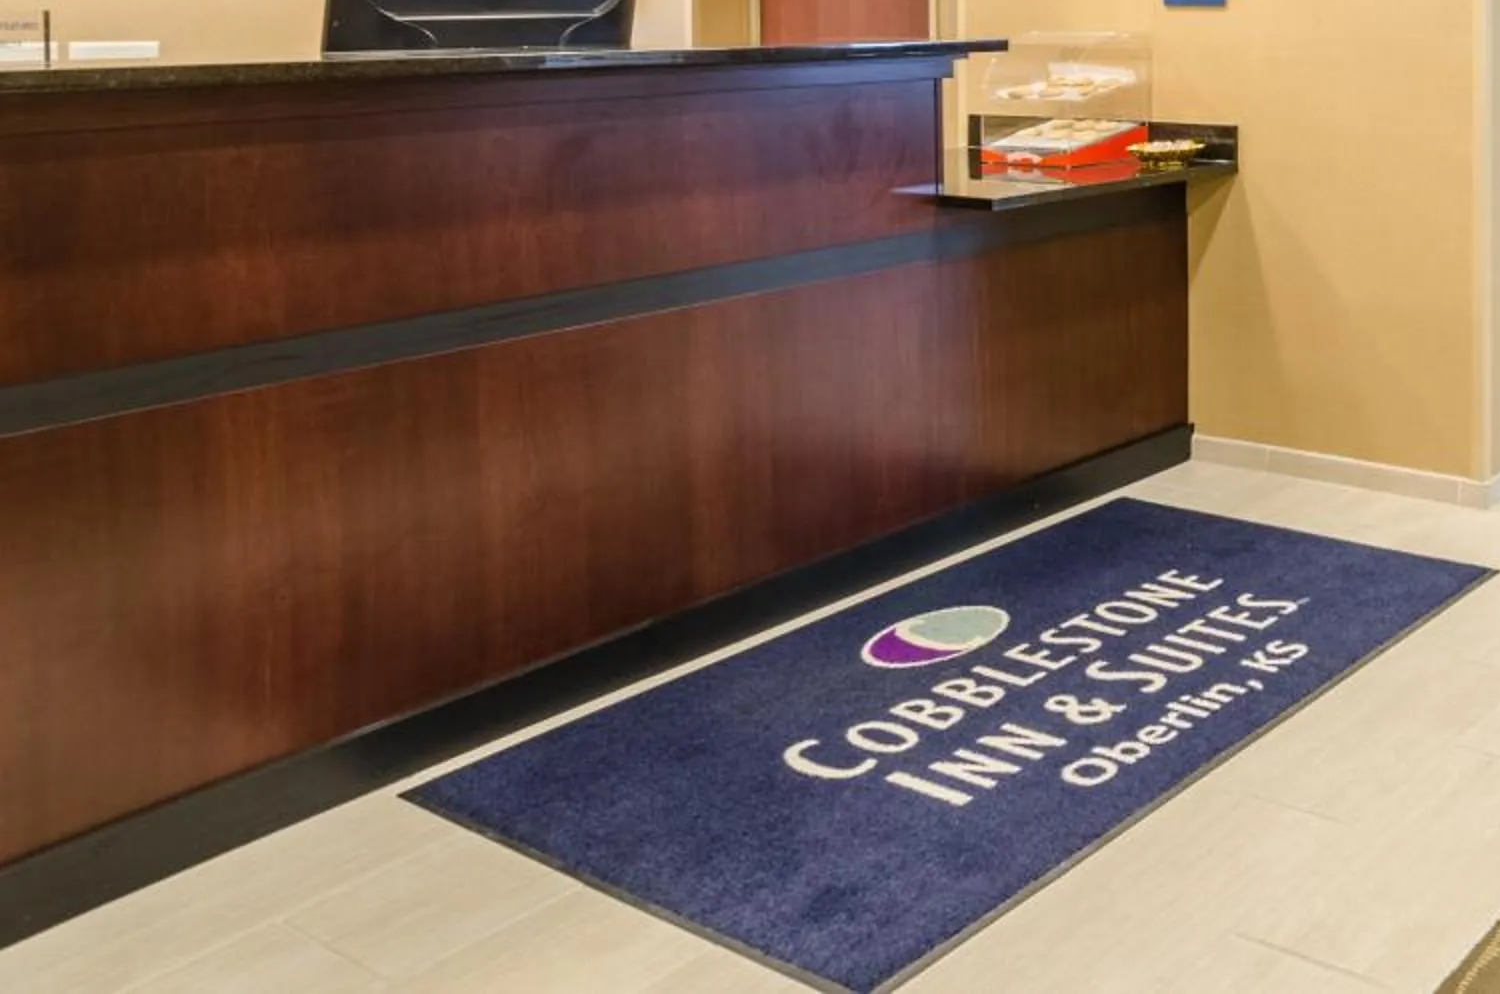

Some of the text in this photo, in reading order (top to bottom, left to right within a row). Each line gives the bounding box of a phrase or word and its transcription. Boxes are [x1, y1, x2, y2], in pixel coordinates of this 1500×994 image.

[783, 568, 1225, 779] COBBLESTONE
[885, 593, 1301, 806] INN & SUITES
